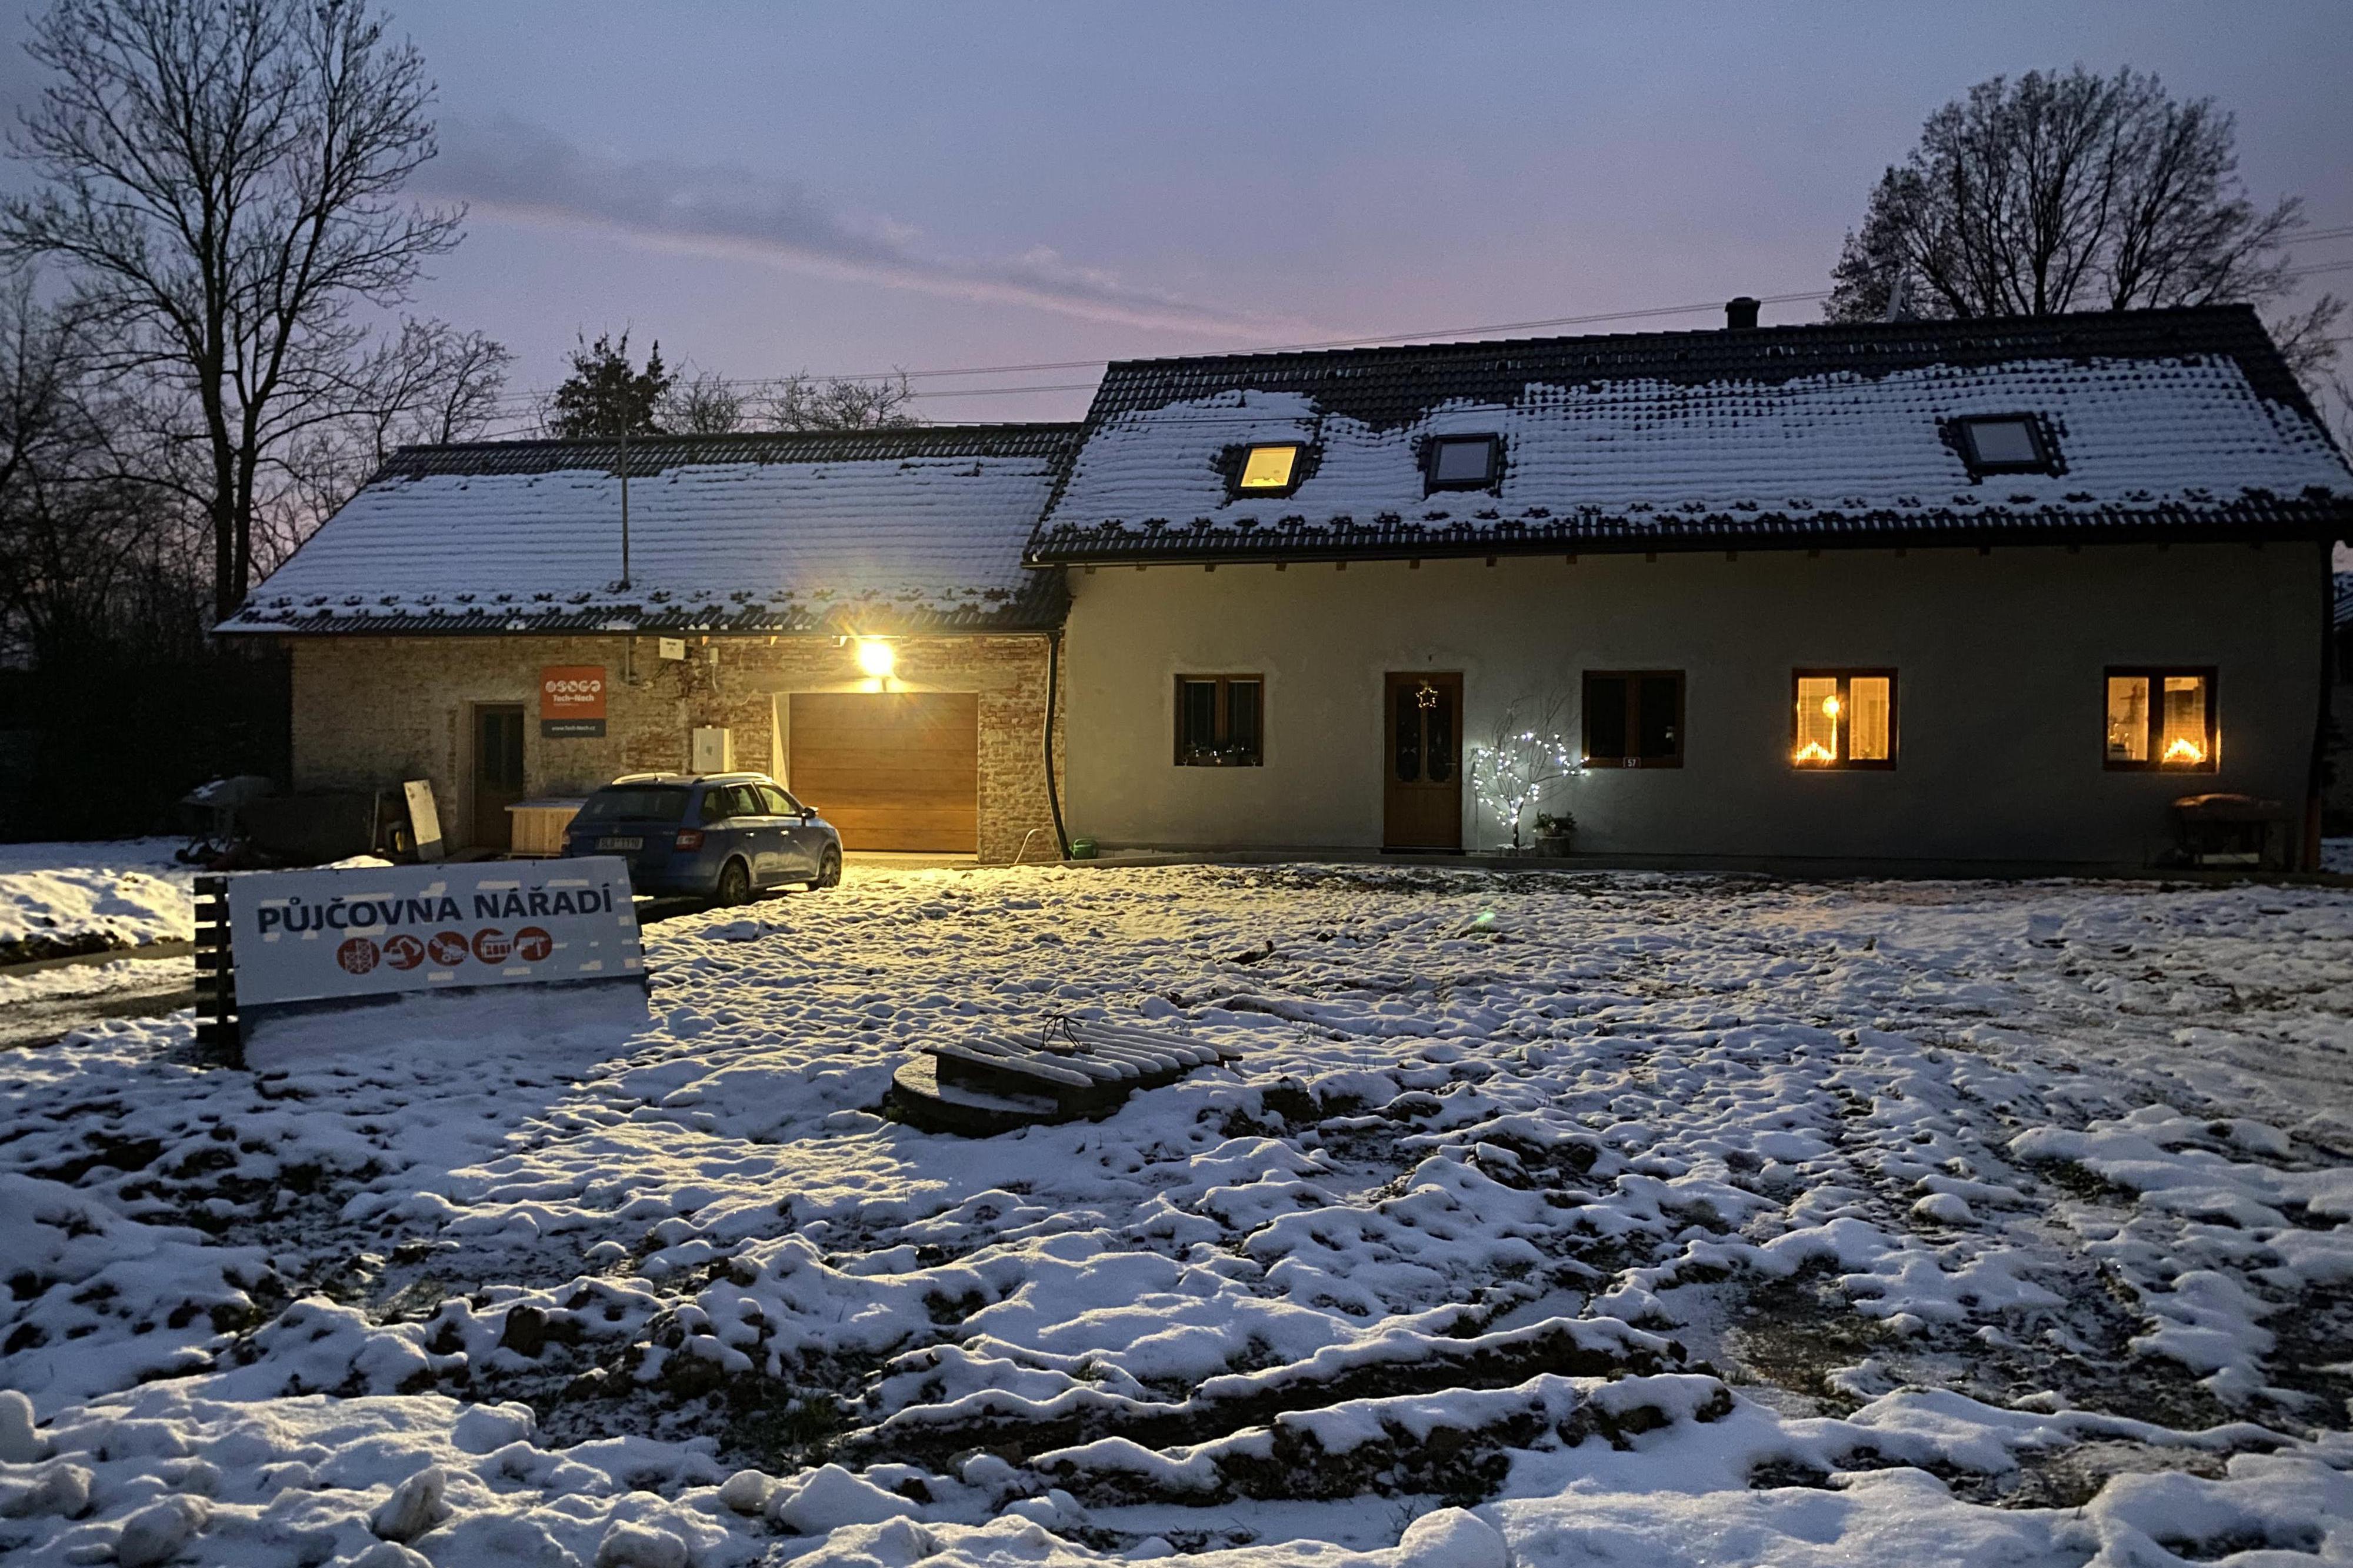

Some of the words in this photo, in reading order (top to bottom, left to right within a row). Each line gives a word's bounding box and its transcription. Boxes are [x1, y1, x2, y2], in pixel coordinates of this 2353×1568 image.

[1628, 759, 1636, 767] 57
[258, 897, 462, 934] PŮJČOVNA
[474, 883, 612, 919] NÁŘADÍ
